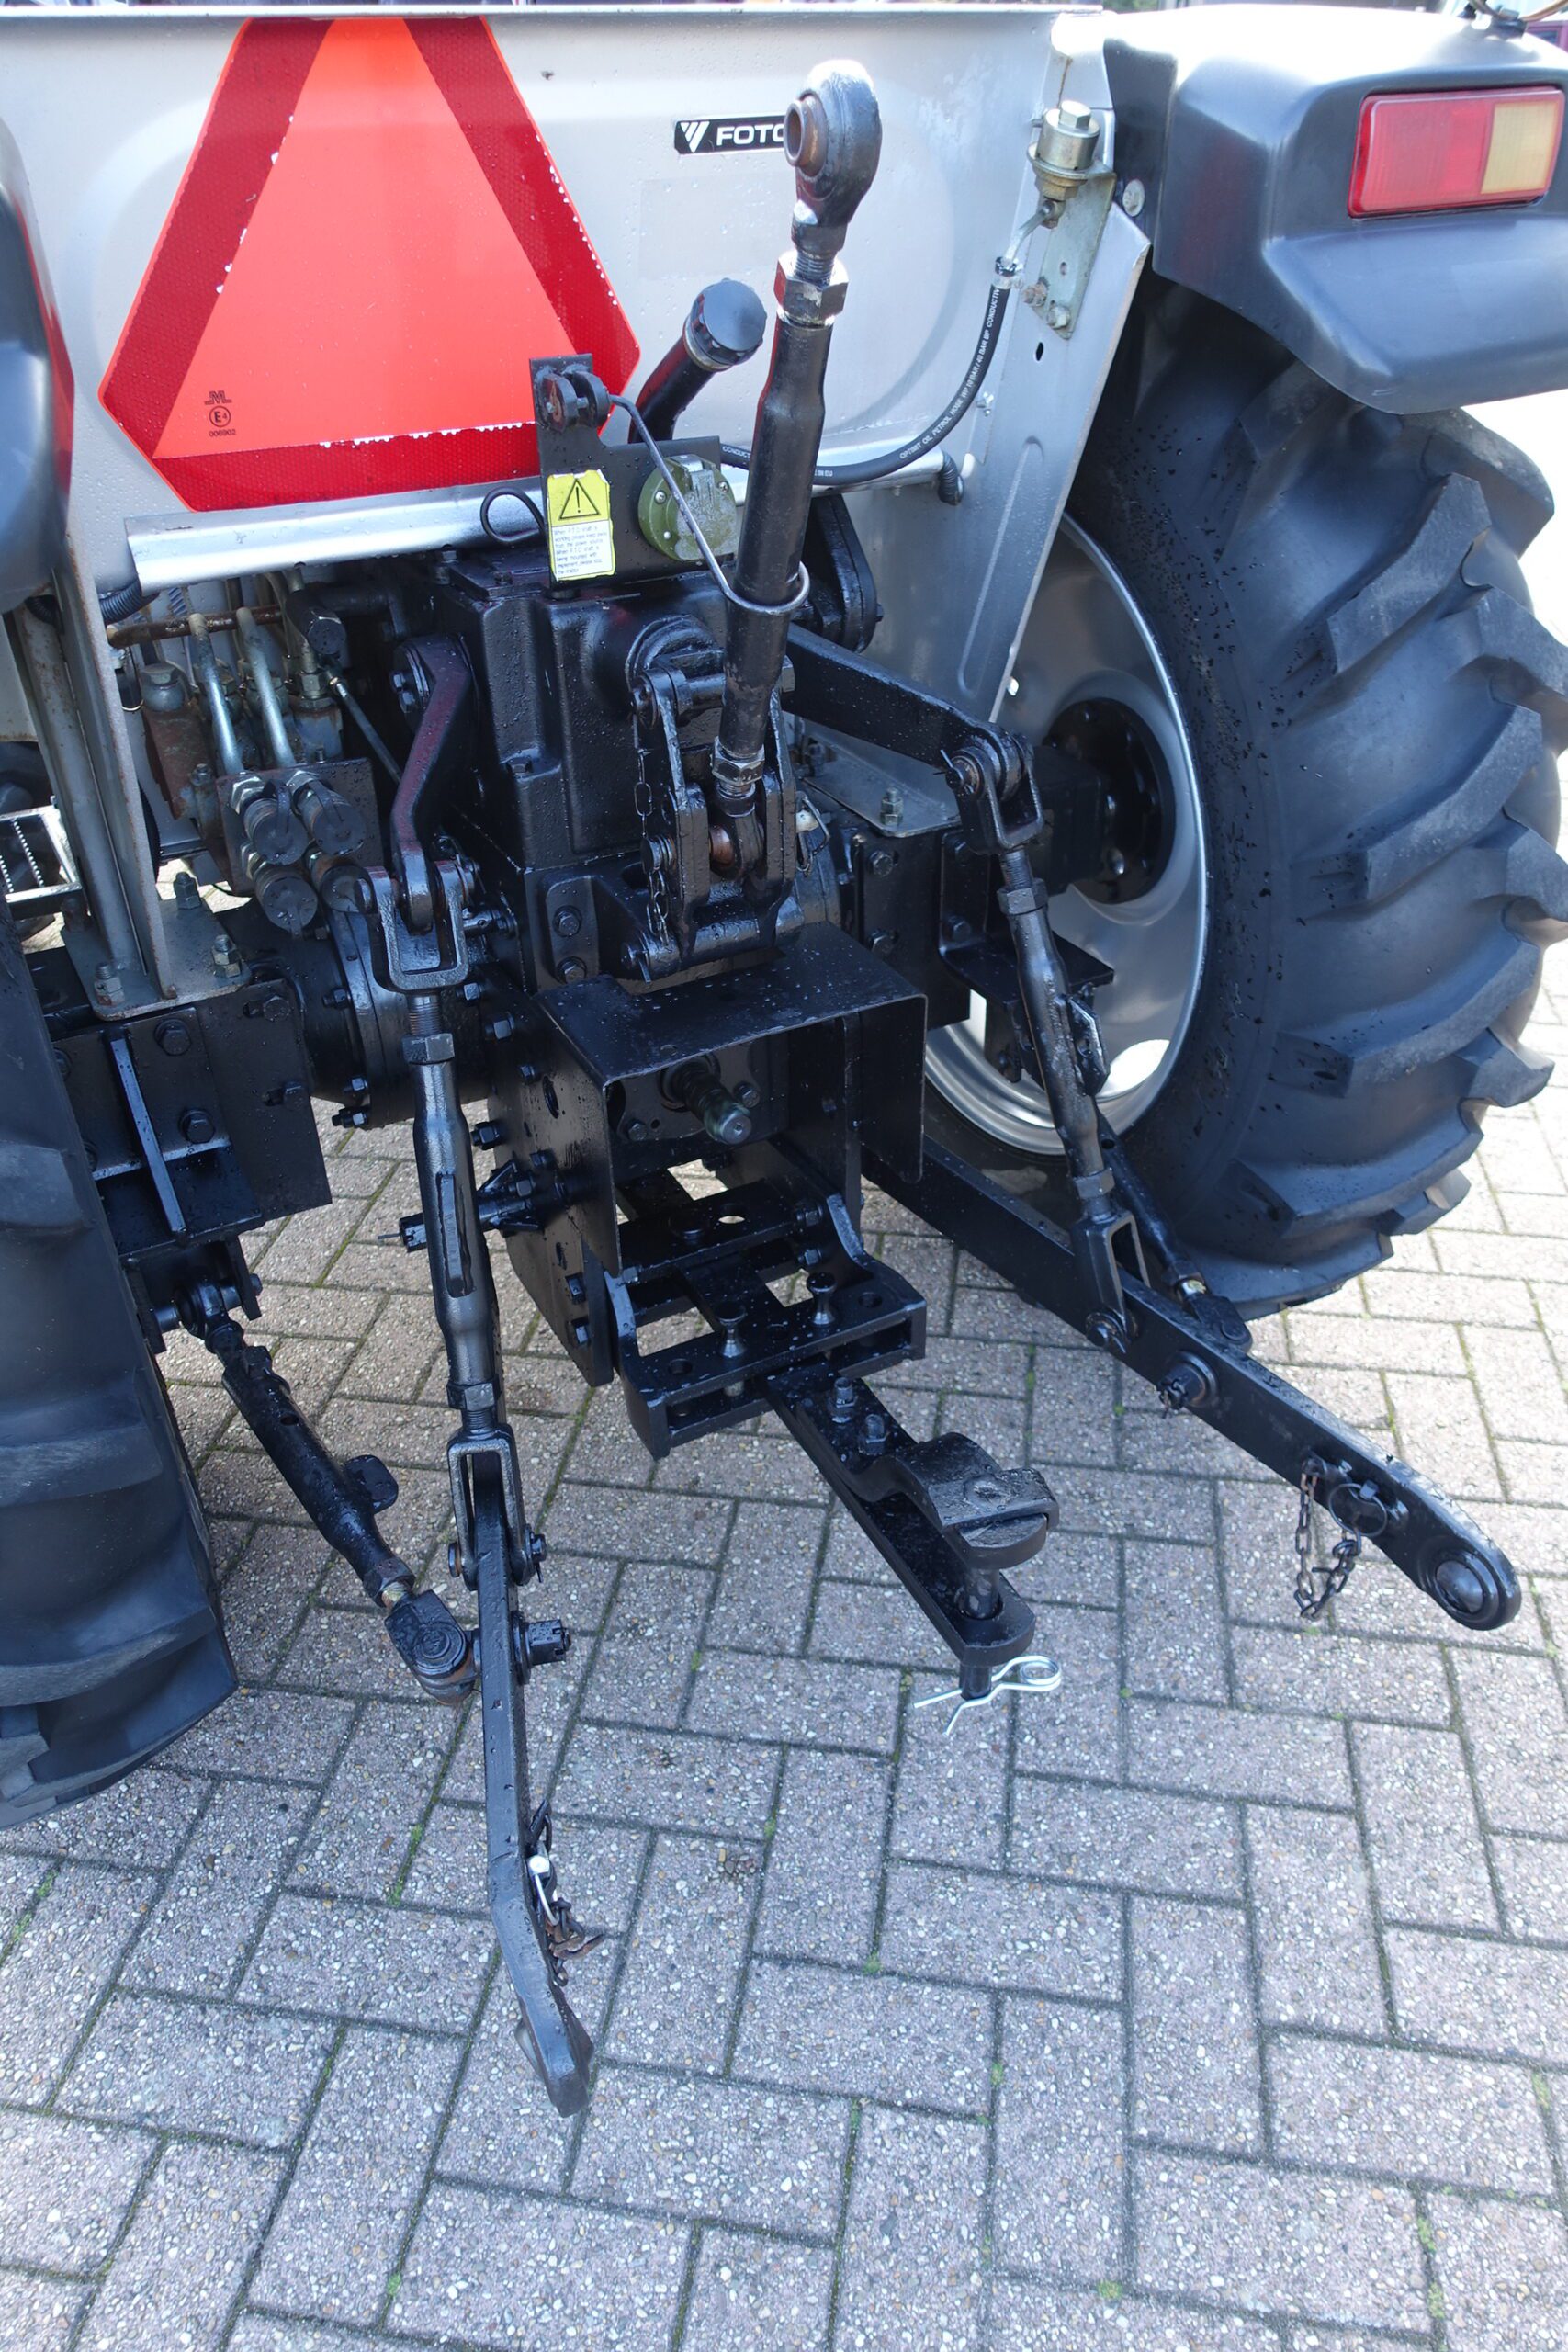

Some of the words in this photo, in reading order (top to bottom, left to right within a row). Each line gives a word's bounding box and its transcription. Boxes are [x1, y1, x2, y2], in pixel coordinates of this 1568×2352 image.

[716, 124, 784, 146] FOTO
[931, 416, 952, 435] PETROL
[950, 399, 963, 415] HOSE
[978, 340, 988, 356] BAR
[986, 288, 1000, 328] CONDUCTIV
[722, 446, 751, 459] CONDUCT
